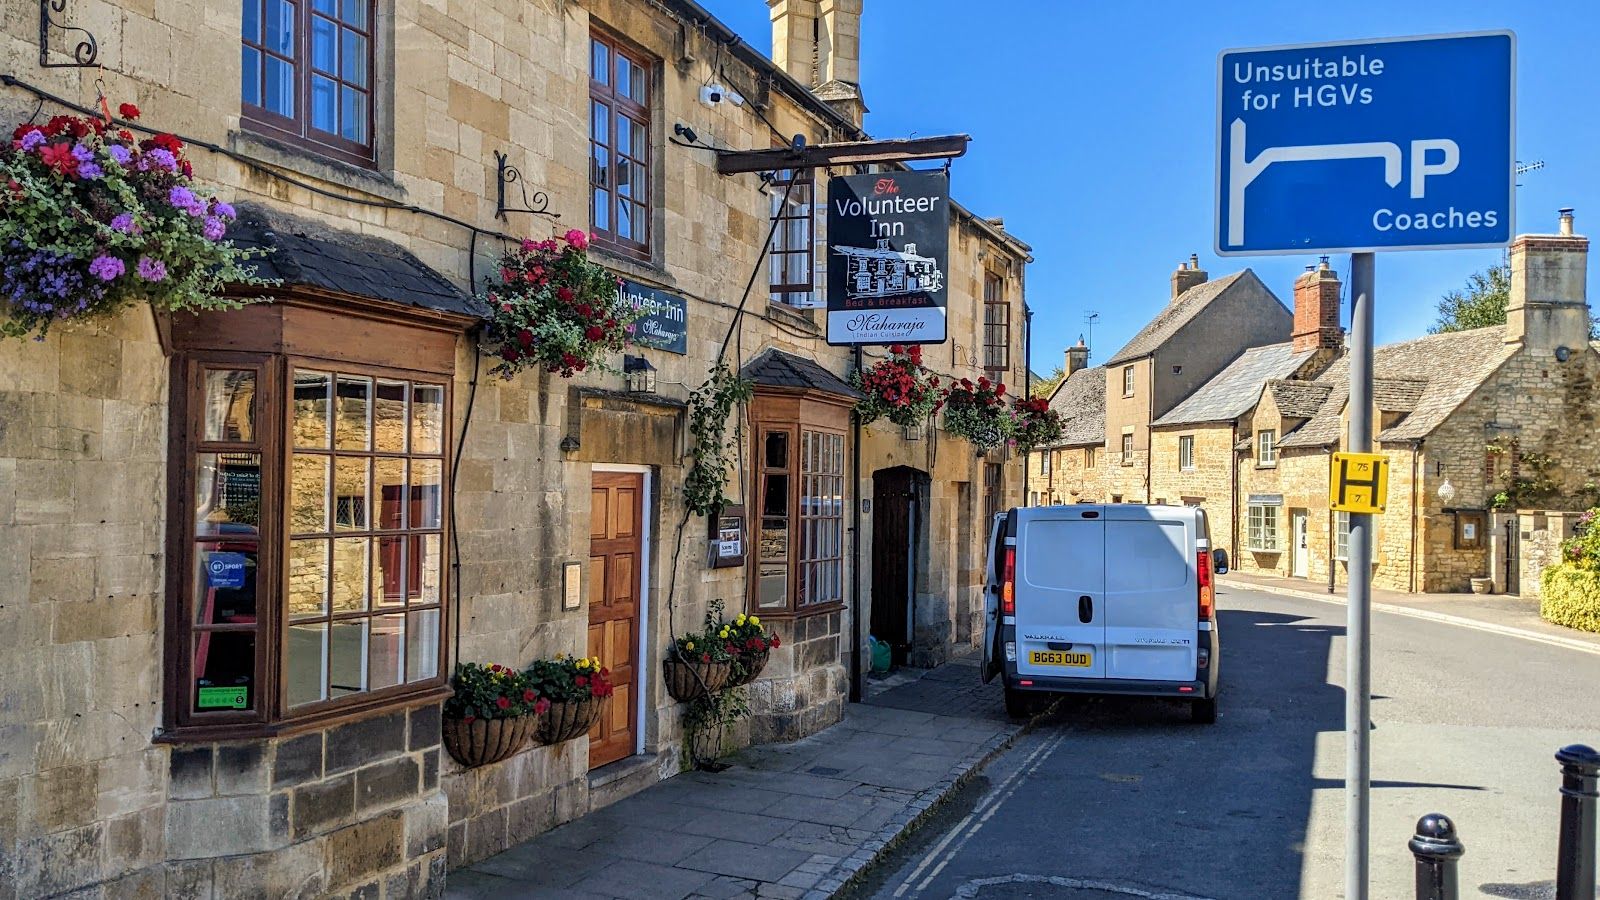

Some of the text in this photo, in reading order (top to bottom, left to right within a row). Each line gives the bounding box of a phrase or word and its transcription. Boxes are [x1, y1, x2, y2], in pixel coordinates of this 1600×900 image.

[1234, 54, 1384, 83] Unsuitable
[1242, 83, 1373, 110] for HGVs
[1410, 138, 1460, 199] P
[874, 178, 900, 195] The
[836, 195, 939, 217] Volunteer
[869, 219, 905, 237] Inn
[1372, 207, 1497, 231] Coaches
[613, 284, 683, 322] olunteer Inn
[845, 297, 928, 307] Bed & Breakfast
[846, 313, 925, 336] Maharaja
[1357, 463, 1369, 471] 75
[1355, 495, 1361, 503] 7
[1034, 653, 1087, 664] BG63 OUD
